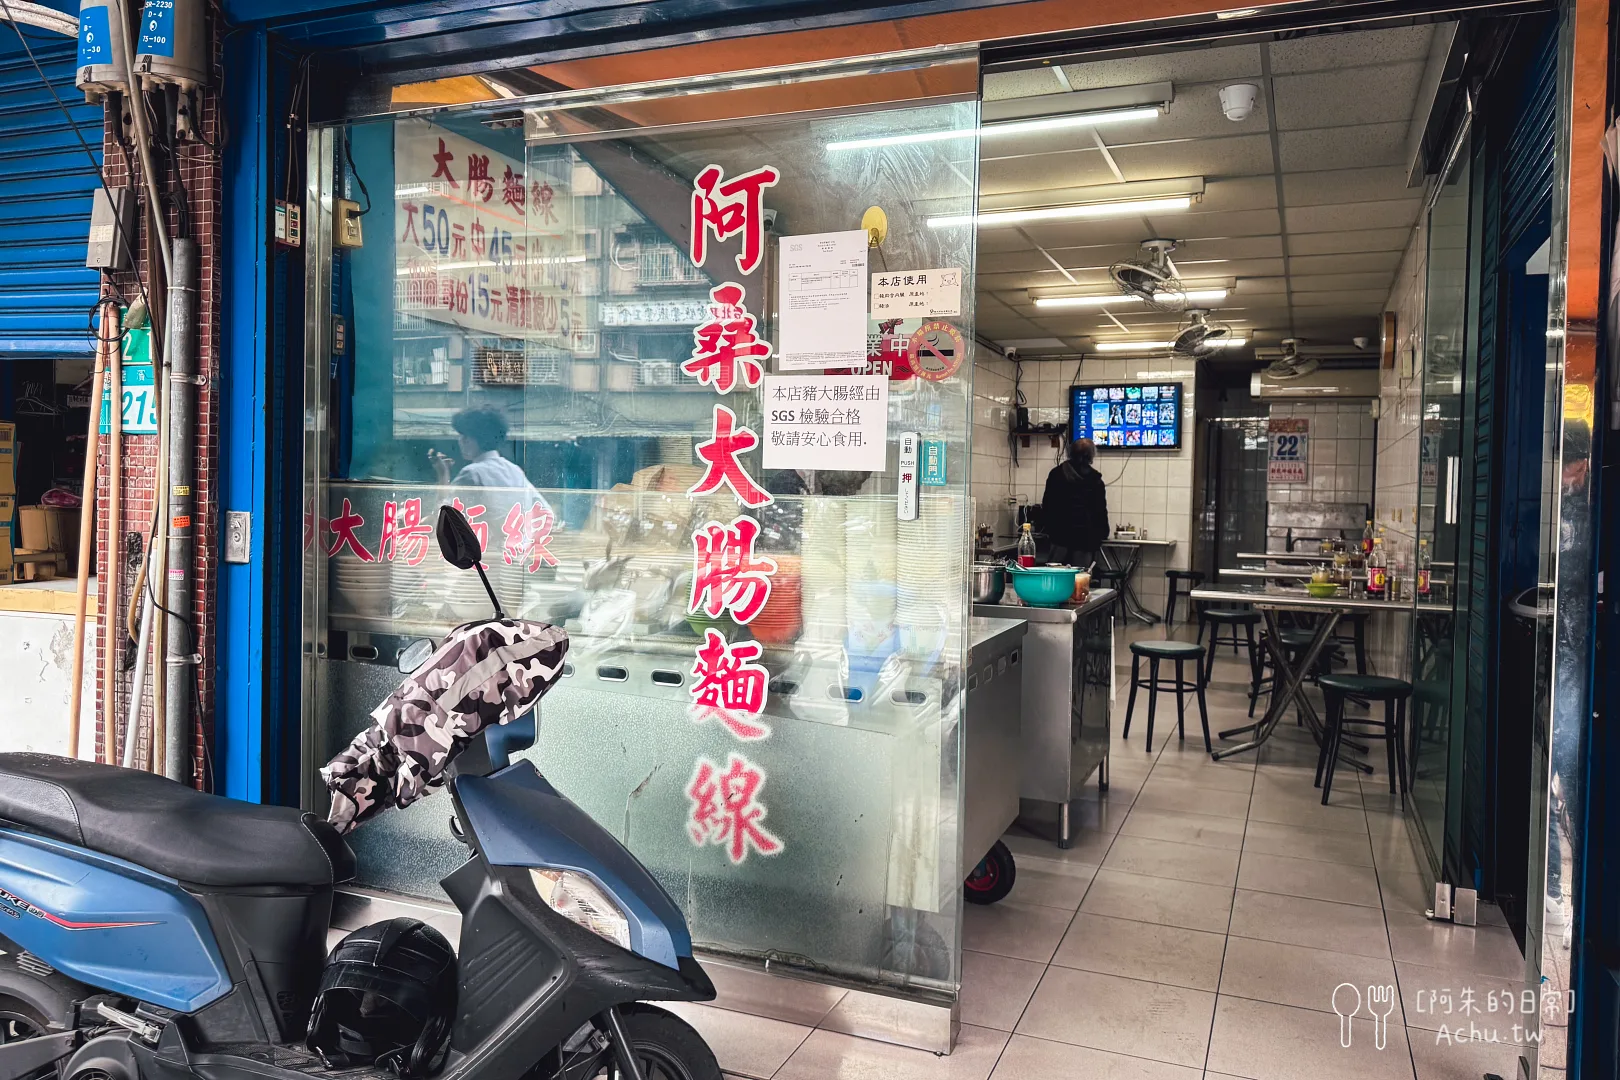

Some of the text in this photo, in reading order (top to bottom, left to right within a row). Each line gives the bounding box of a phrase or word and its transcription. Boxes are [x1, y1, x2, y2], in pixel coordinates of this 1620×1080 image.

[431, 137, 559, 226] 大腸麵線
[789, 243, 803, 252] SGS
[878, 275, 927, 287] 本店使用
[772, 385, 880, 401] 本店豬大腸經由
[771, 408, 860, 424] SGS 檢驗合格
[771, 431, 867, 447] 敬請安心食用.
[904, 438, 912, 454] 自動
[1277, 435, 1298, 456] 22
[928, 446, 938, 475] 自動門
[902, 473, 912, 483] 押
[680, 163, 785, 866] 阿桑大腸麵線
